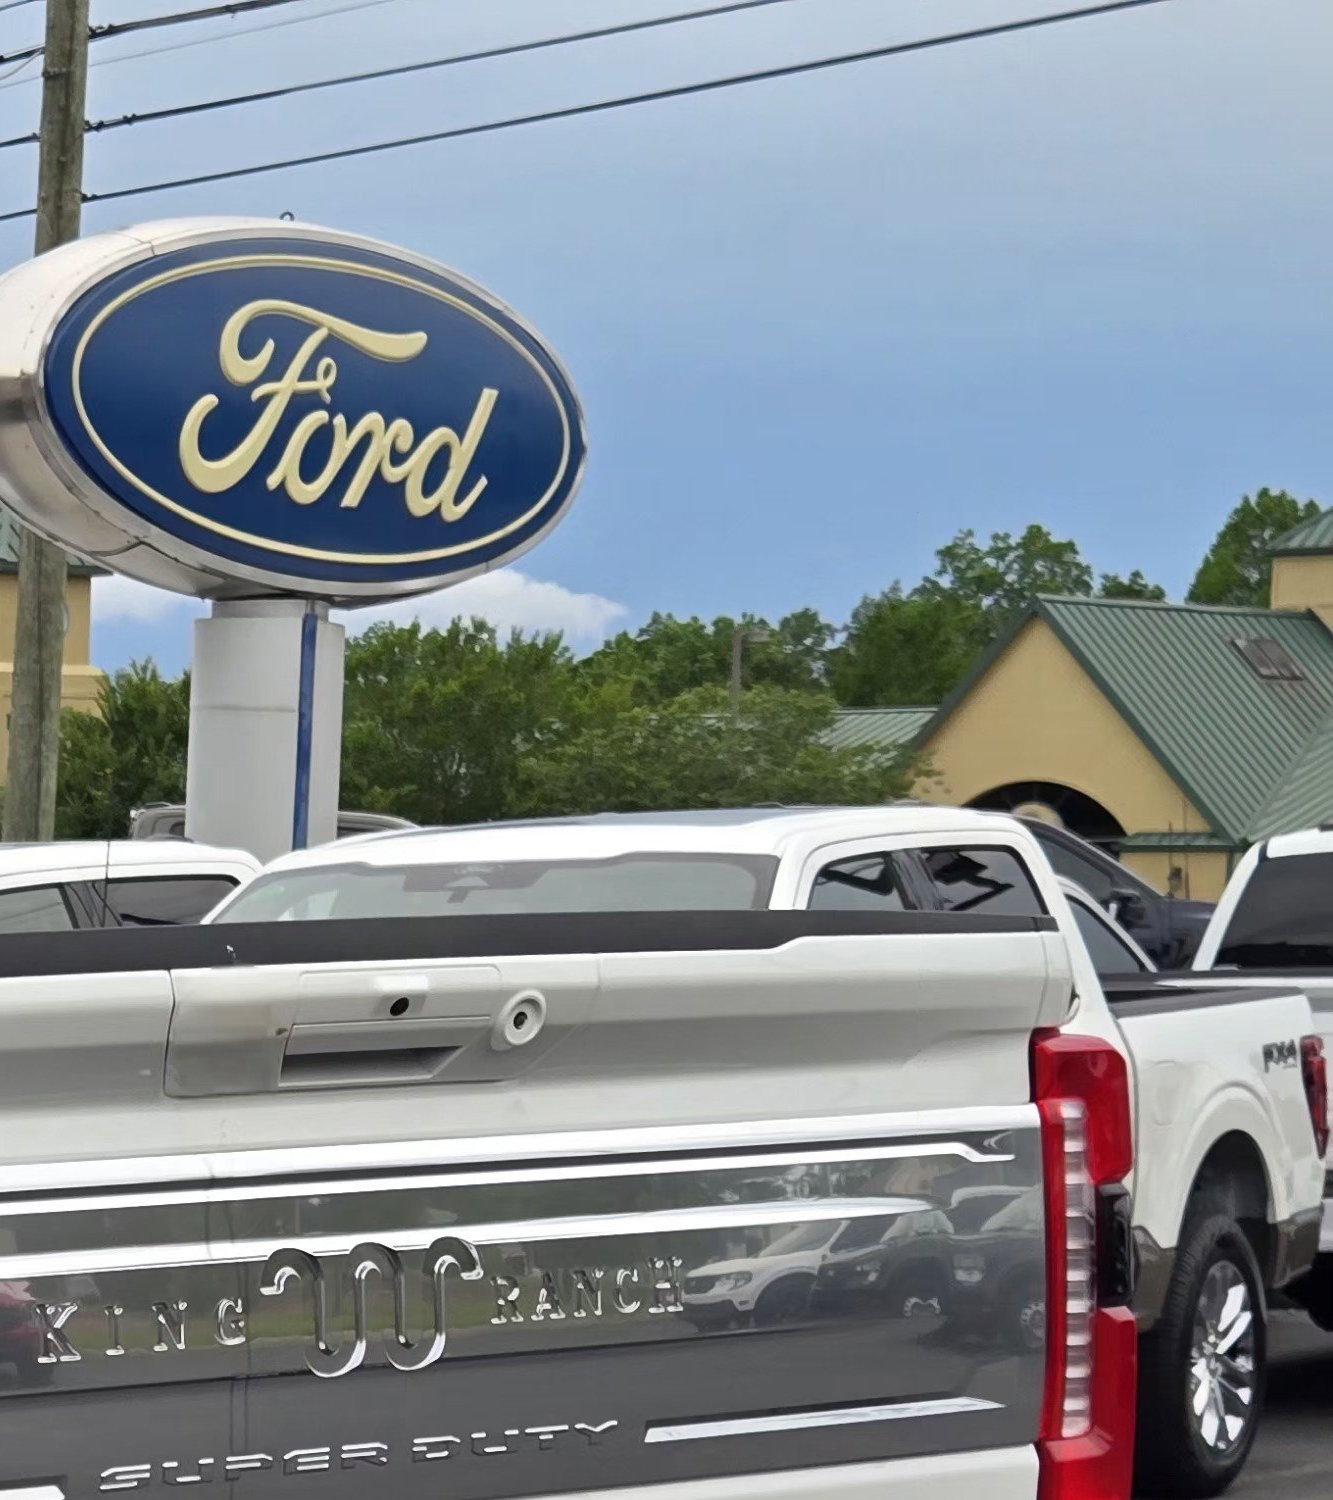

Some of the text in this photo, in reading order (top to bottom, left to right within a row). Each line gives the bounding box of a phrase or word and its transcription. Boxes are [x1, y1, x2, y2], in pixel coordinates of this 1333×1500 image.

[179, 299, 499, 523] Ford
[36, 1256, 684, 1364] KING RANCH
[99, 1419, 619, 1491] SUPER DUTY
